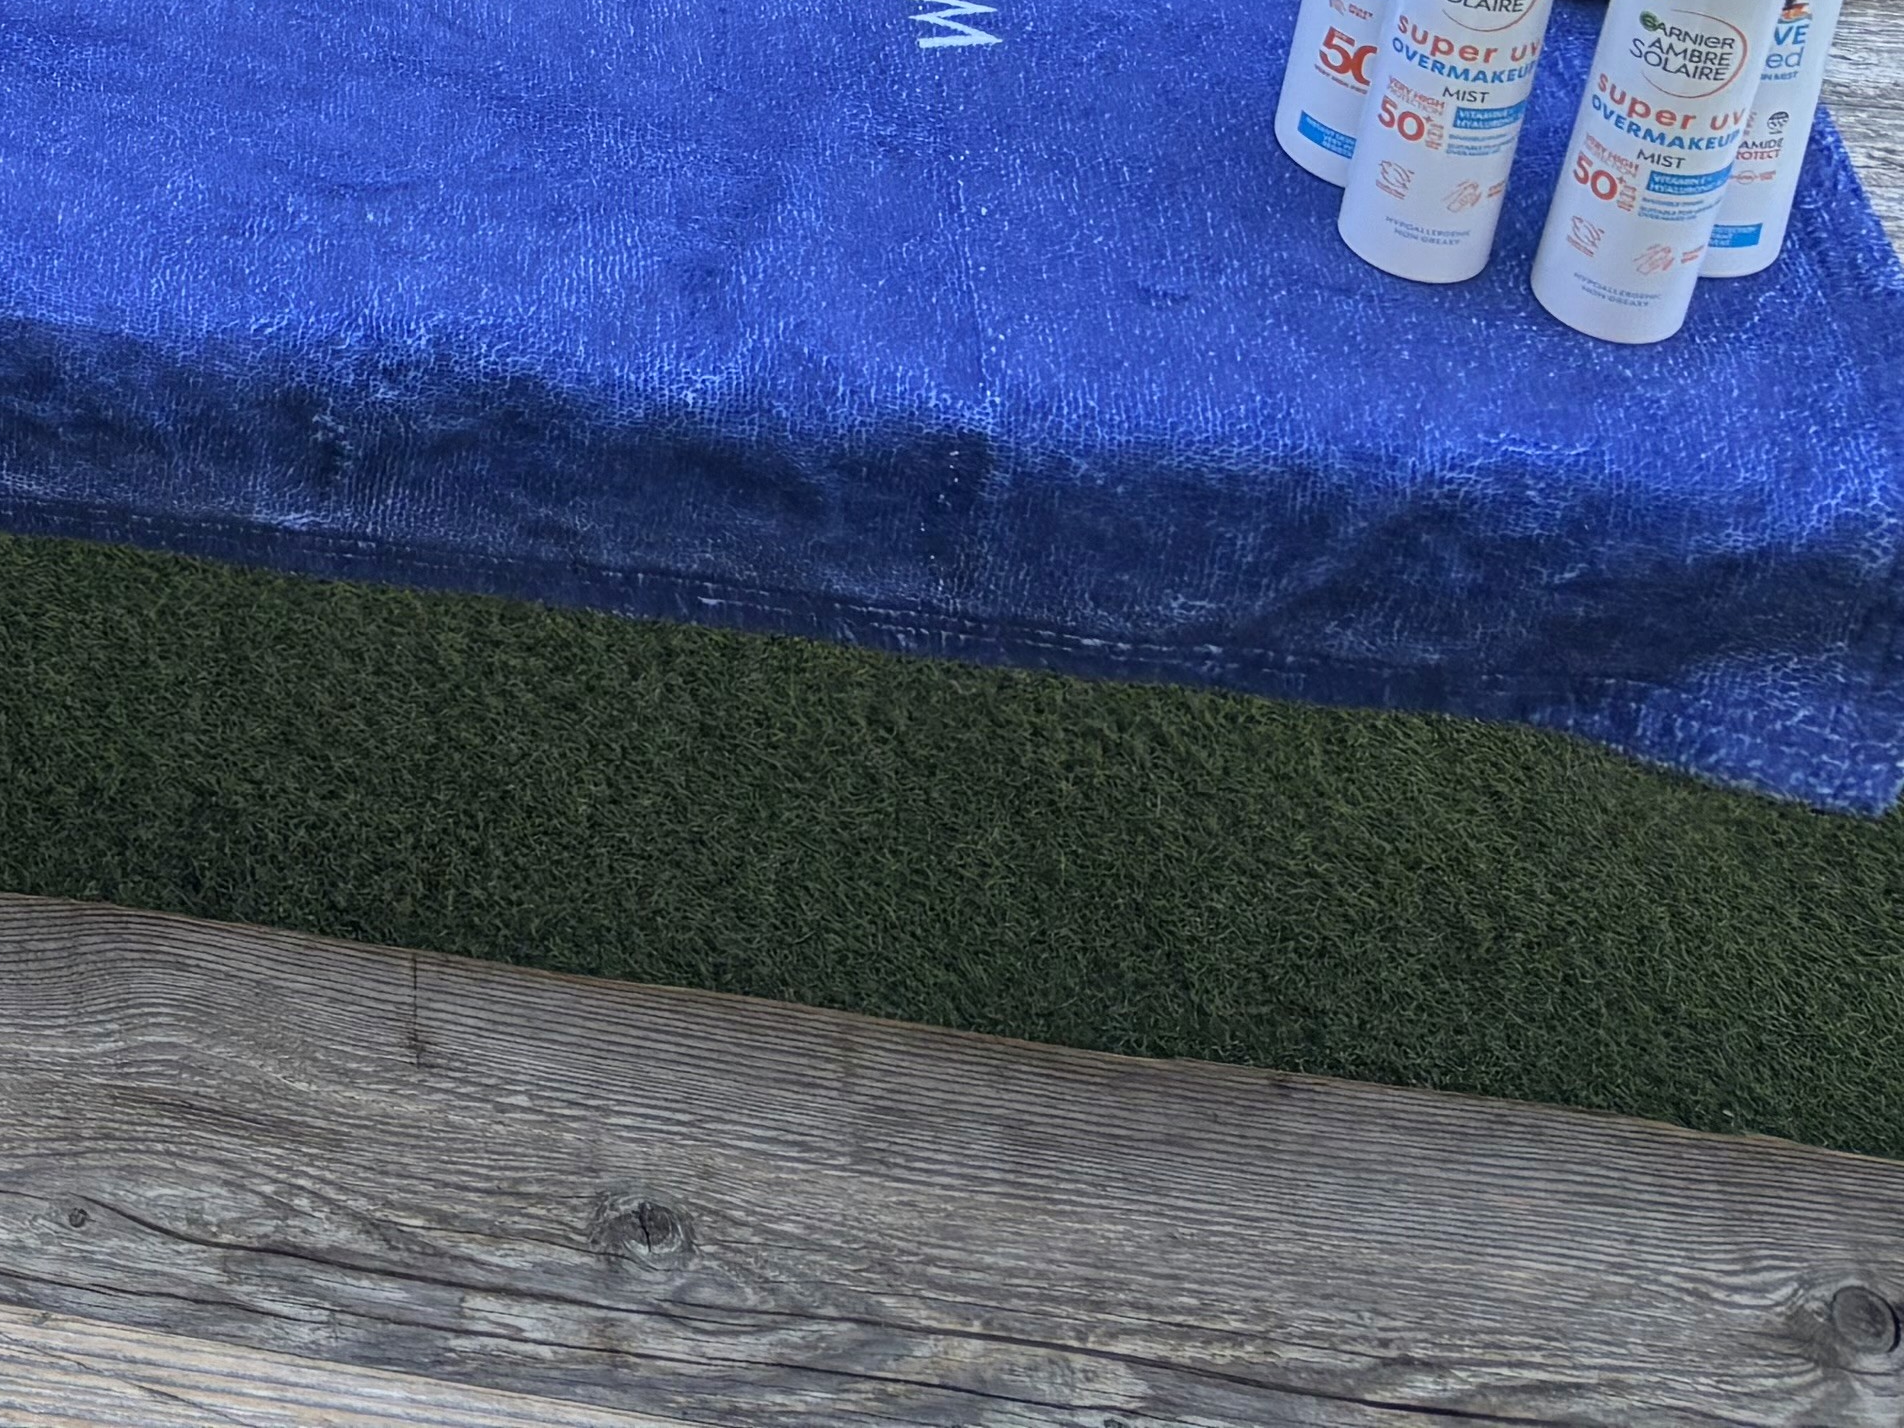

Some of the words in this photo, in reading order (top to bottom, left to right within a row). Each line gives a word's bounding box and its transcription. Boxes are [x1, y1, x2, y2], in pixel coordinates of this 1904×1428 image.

[1398, 15, 1498, 64] super
[1648, 38, 1733, 66] AMBRE
[1629, 38, 1729, 81] SOLAIRE
[1442, 86, 1490, 104] MIST
[1597, 73, 1697, 130] super
[1636, 148, 1686, 169] MIST
